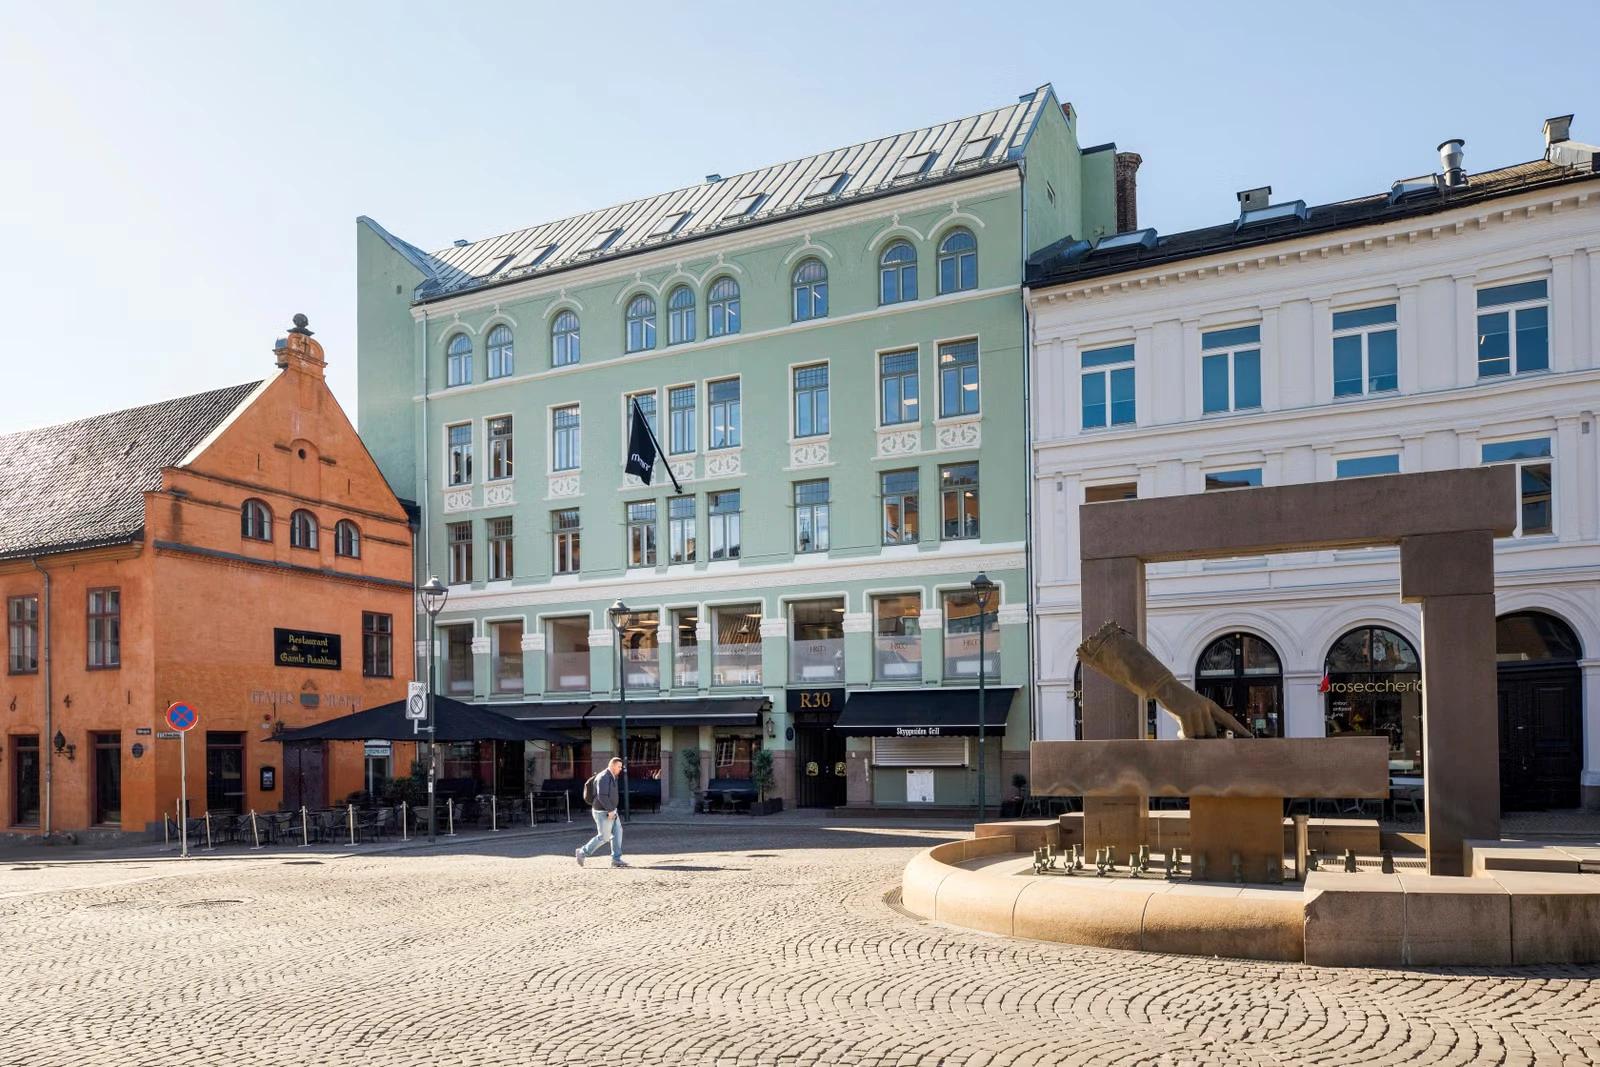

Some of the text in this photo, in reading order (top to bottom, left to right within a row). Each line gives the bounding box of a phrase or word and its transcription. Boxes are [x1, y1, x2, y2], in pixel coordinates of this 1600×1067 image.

[280, 652, 304, 663] Gamle
[9, 696, 17, 712] 6
[800, 692, 830, 708] R30
[896, 727, 940, 736] Skyggesiden Grill
